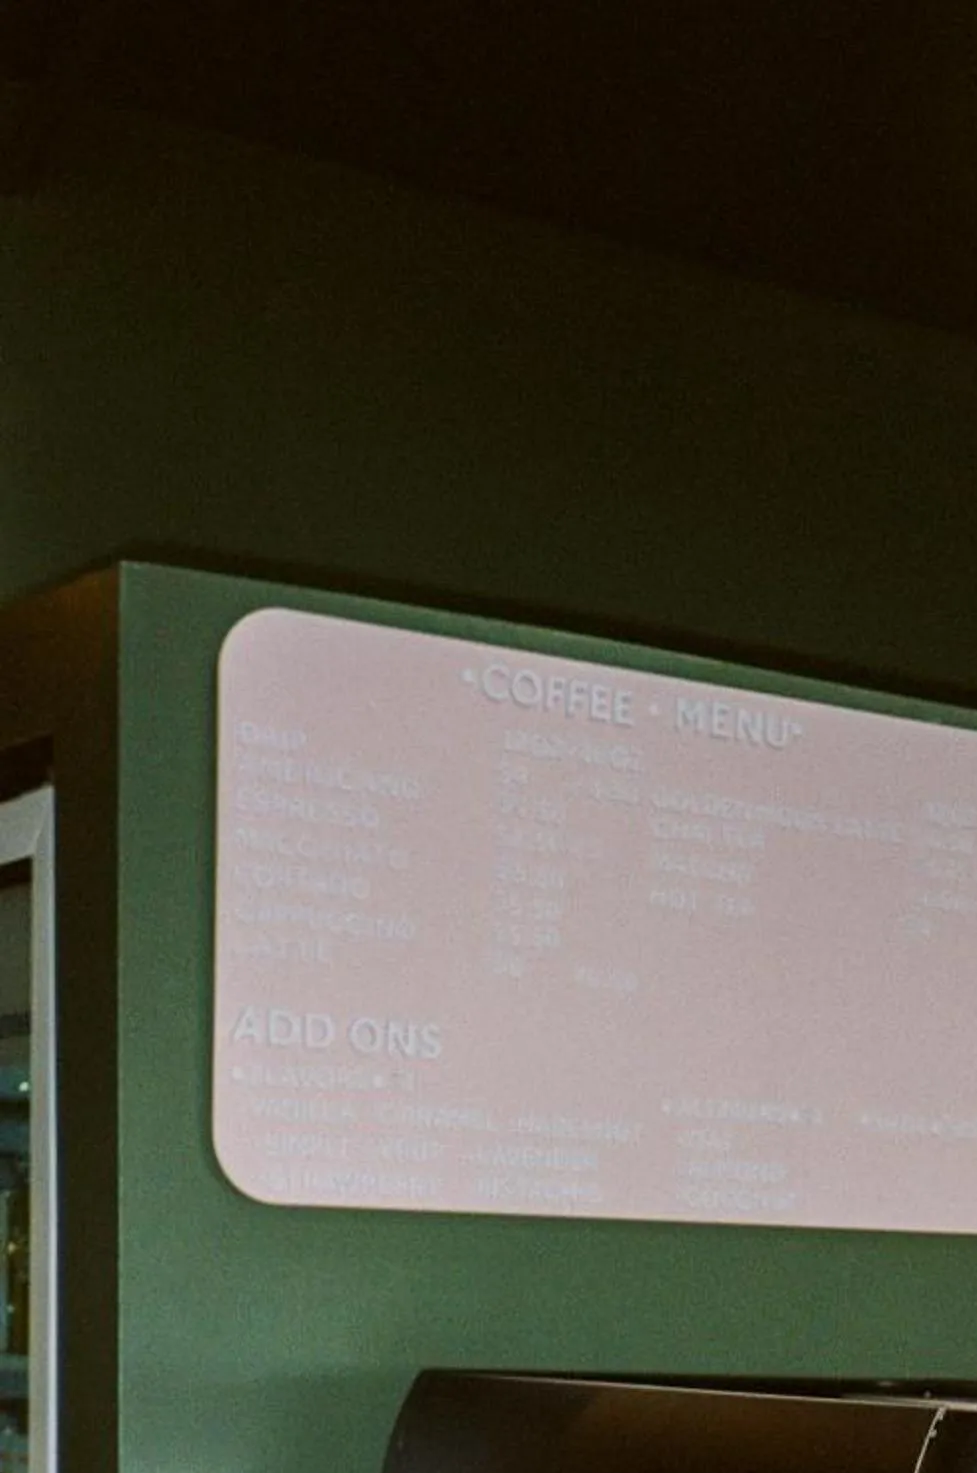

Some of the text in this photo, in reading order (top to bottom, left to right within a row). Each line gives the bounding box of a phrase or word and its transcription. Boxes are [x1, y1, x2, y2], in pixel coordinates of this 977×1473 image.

[481, 663, 792, 748] COFFEE MENU
[232, 1005, 443, 1060] ADD ONS
